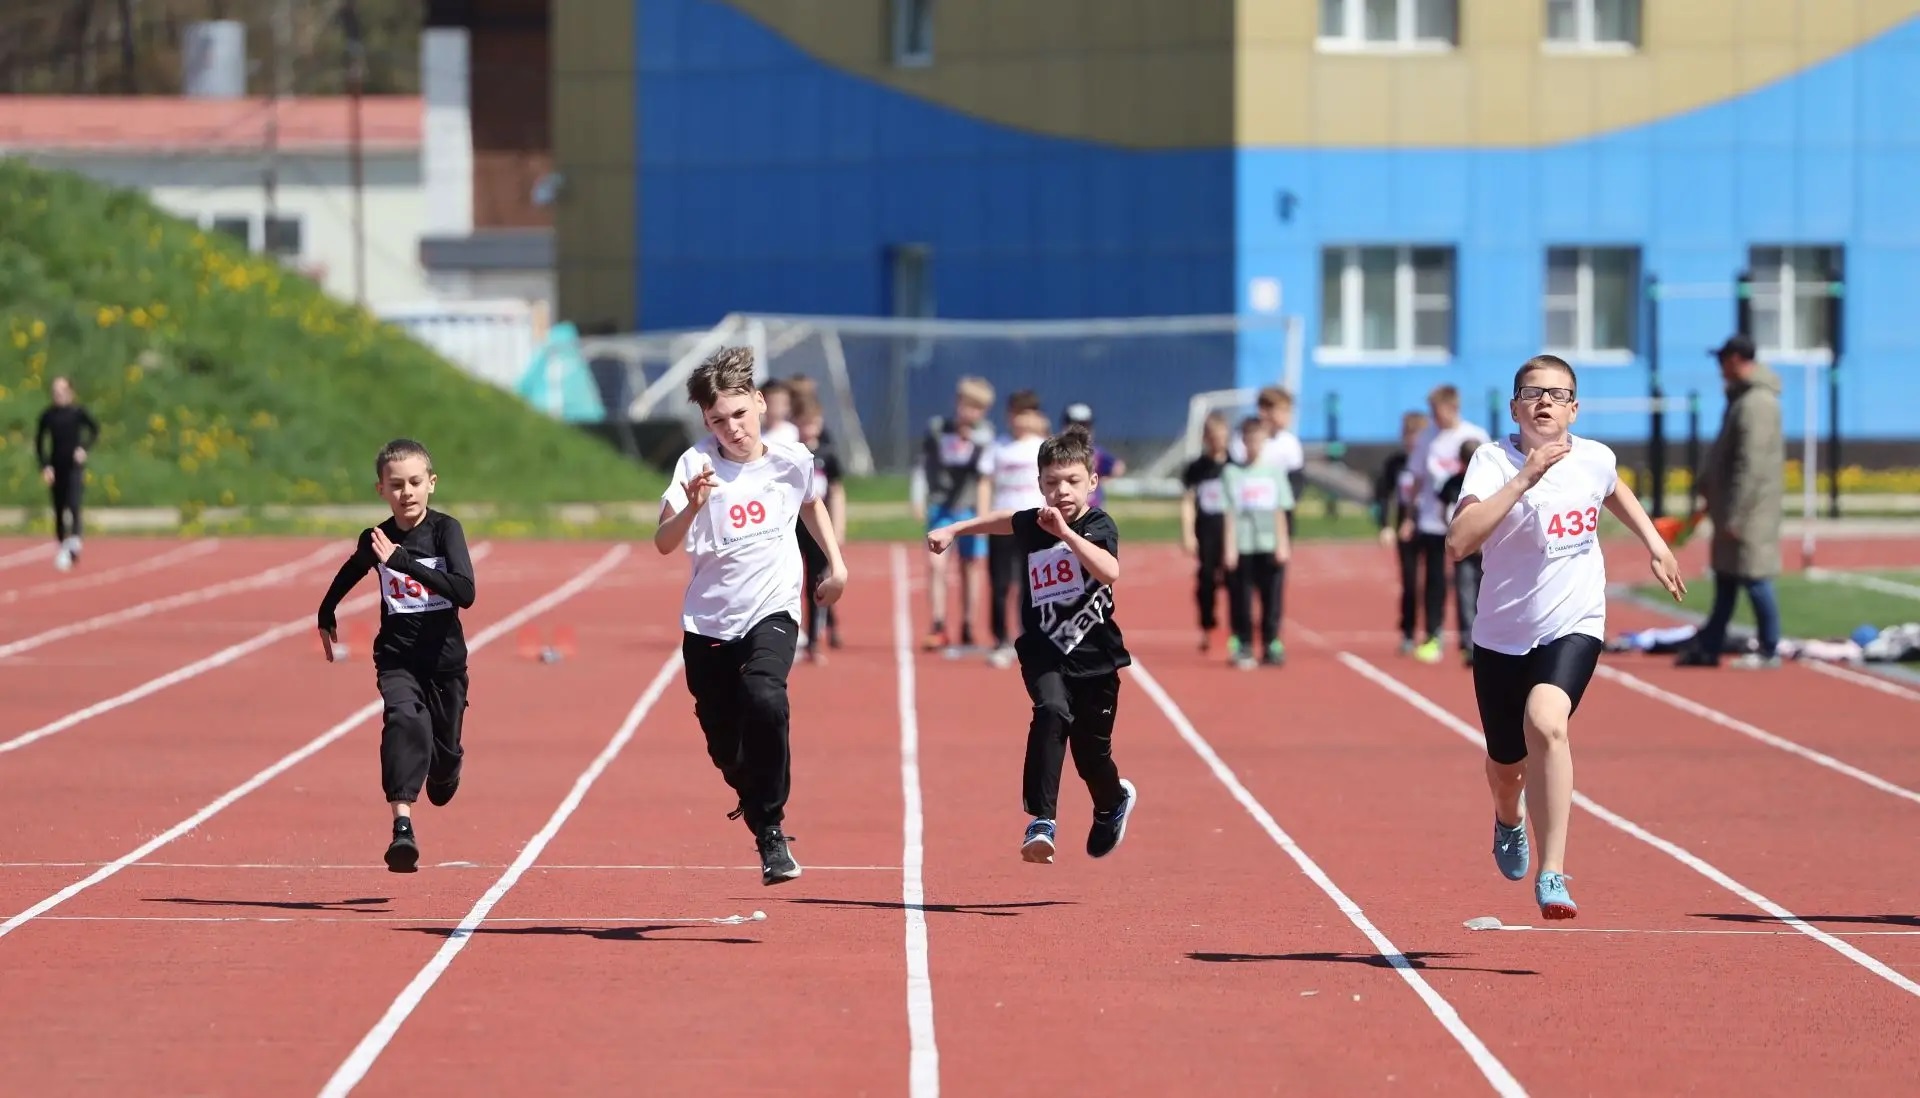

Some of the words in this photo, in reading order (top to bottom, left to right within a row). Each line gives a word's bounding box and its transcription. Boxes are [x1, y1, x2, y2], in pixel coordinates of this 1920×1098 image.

[729, 500, 766, 529] 99
[1547, 506, 1598, 539] 433
[389, 576, 439, 599] 15
[1031, 559, 1074, 590] 118
